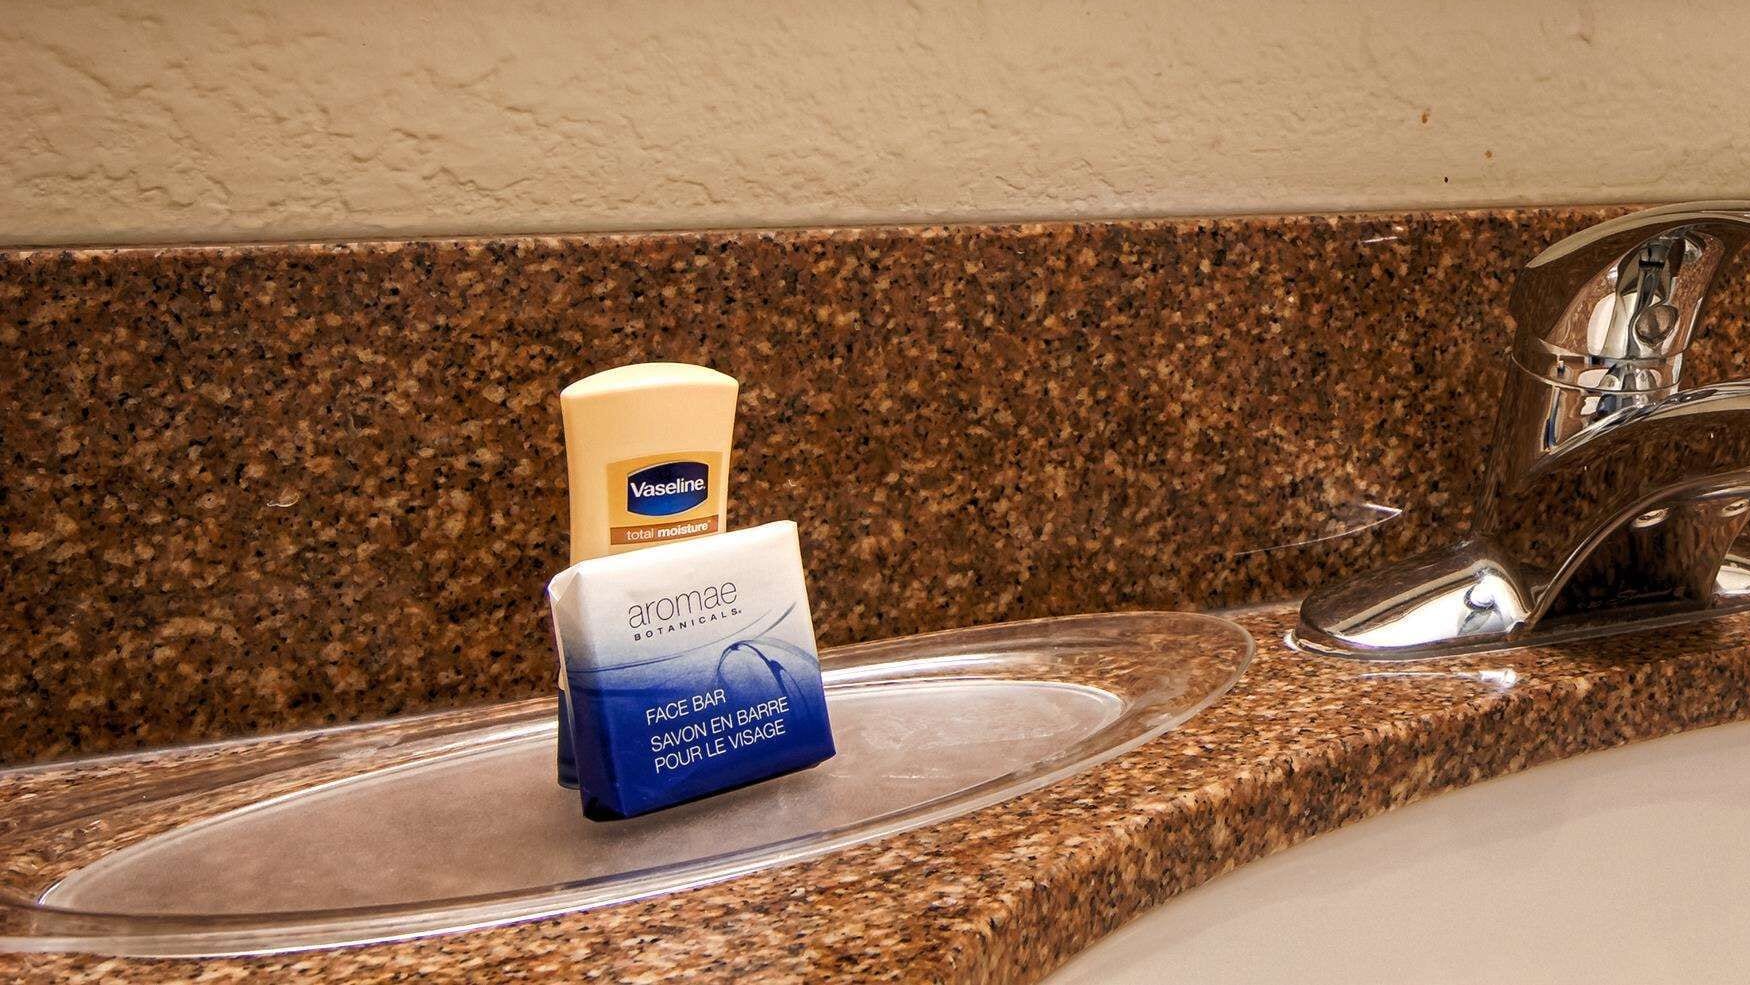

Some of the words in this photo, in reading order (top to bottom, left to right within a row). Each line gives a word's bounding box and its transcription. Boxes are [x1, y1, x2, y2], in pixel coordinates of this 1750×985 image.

[626, 528, 654, 540] total
[658, 521, 709, 538] moisture
[628, 582, 737, 629] aromae
[646, 699, 689, 725] FACE
[692, 689, 726, 712] BAR
[651, 722, 706, 752] SAVON
[711, 714, 732, 734] EN
[737, 696, 790, 726] BARRE
[655, 746, 702, 774] POUR
[706, 738, 726, 758] LE
[729, 719, 785, 749] VISAGE
